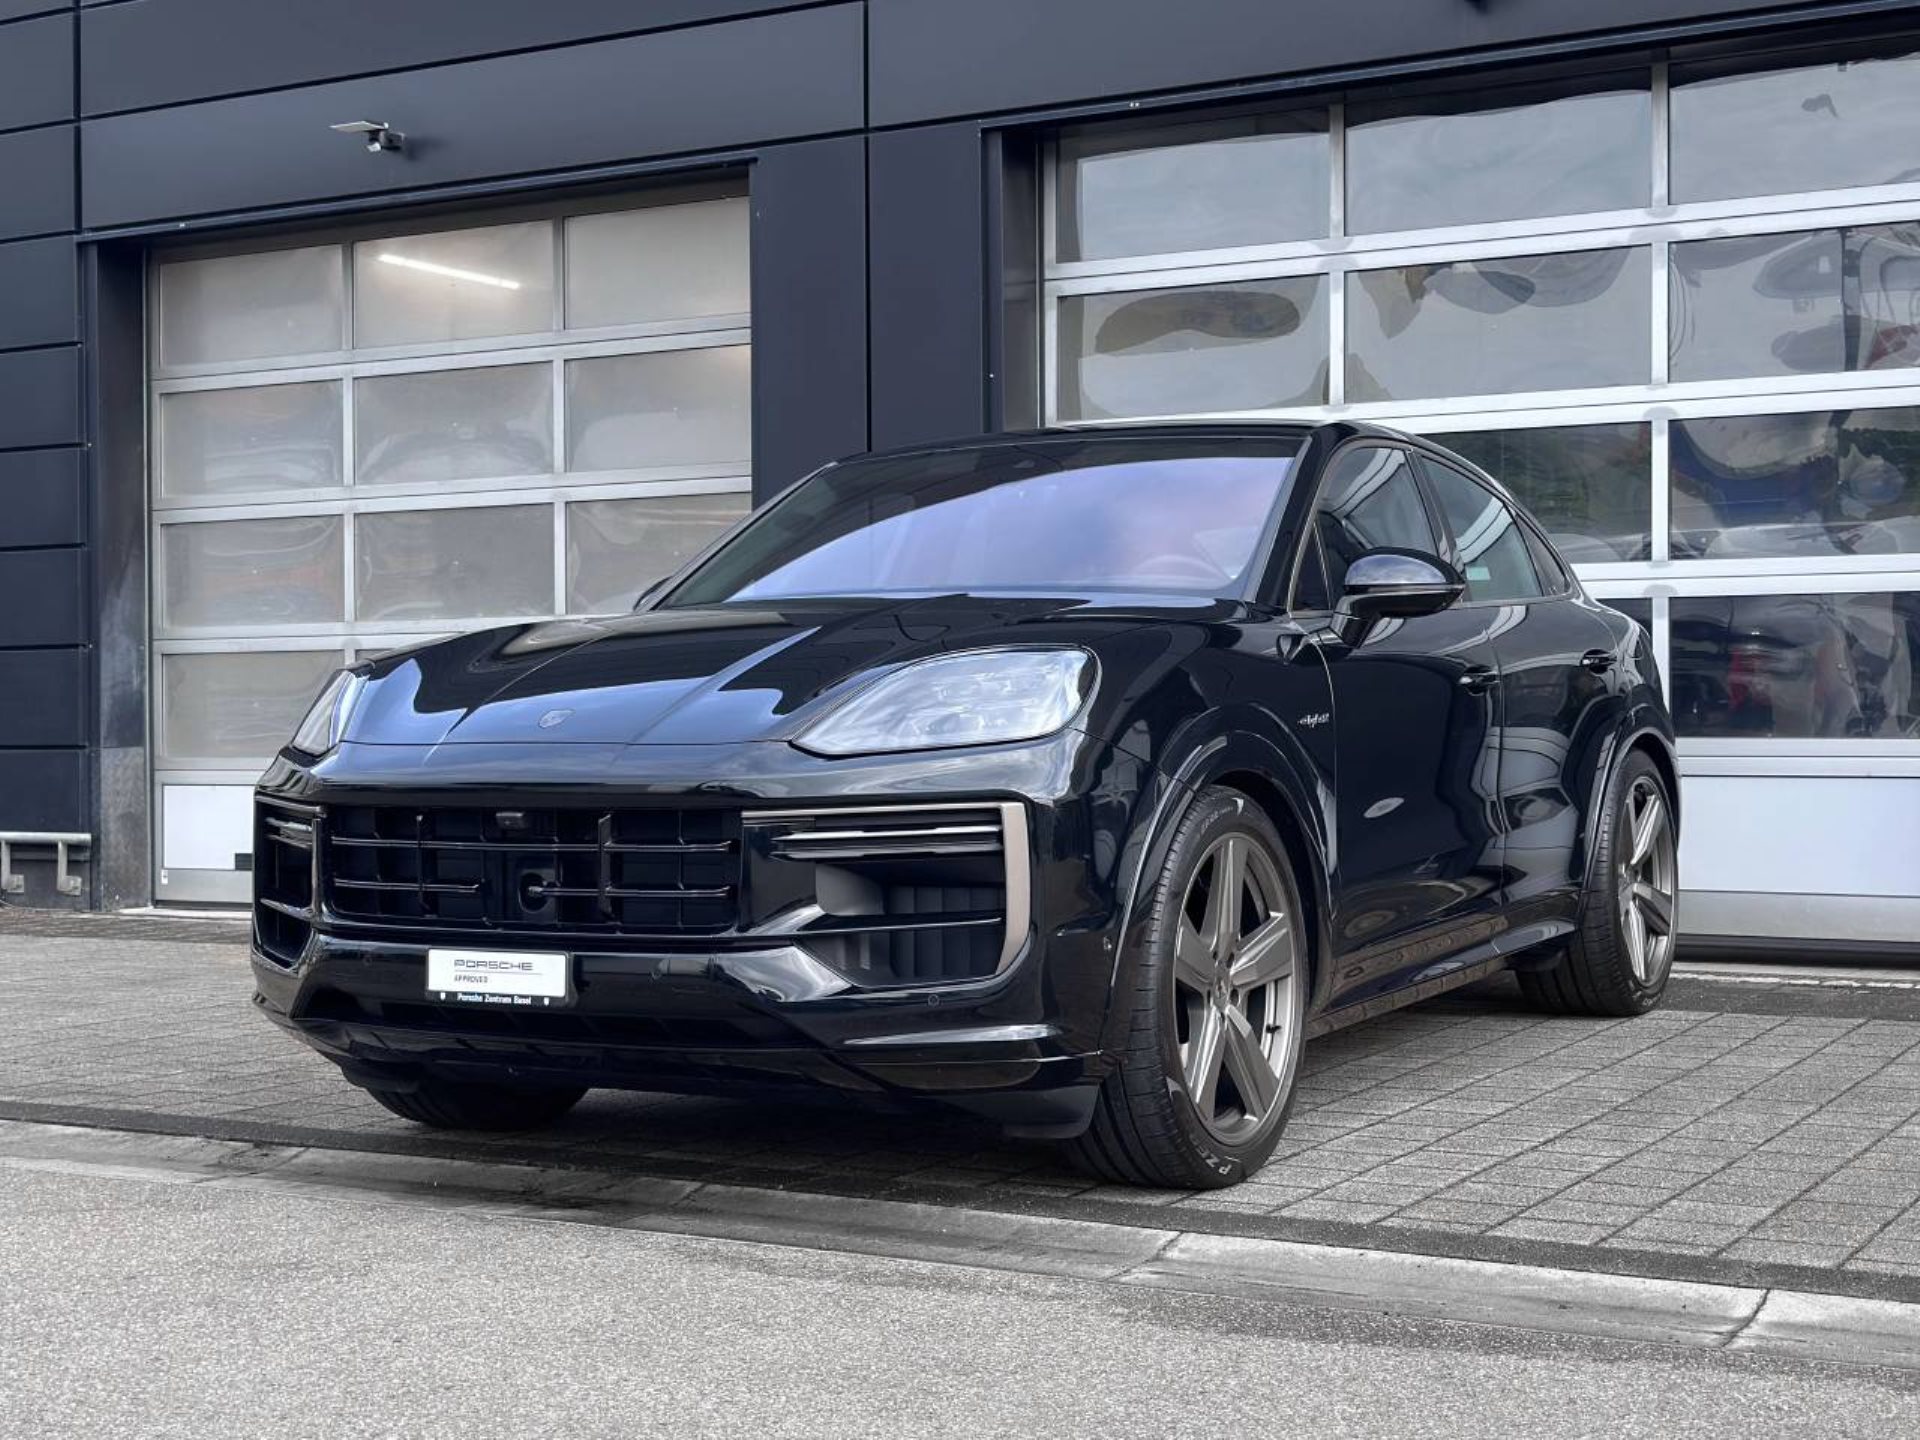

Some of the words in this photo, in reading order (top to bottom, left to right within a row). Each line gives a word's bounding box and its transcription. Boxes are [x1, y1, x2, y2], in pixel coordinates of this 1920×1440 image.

[454, 959, 534, 971] PORSCHE
[454, 974, 488, 983] APPROVED
[457, 992, 483, 1002] Porsche
[484, 994, 512, 1003] Zentrum
